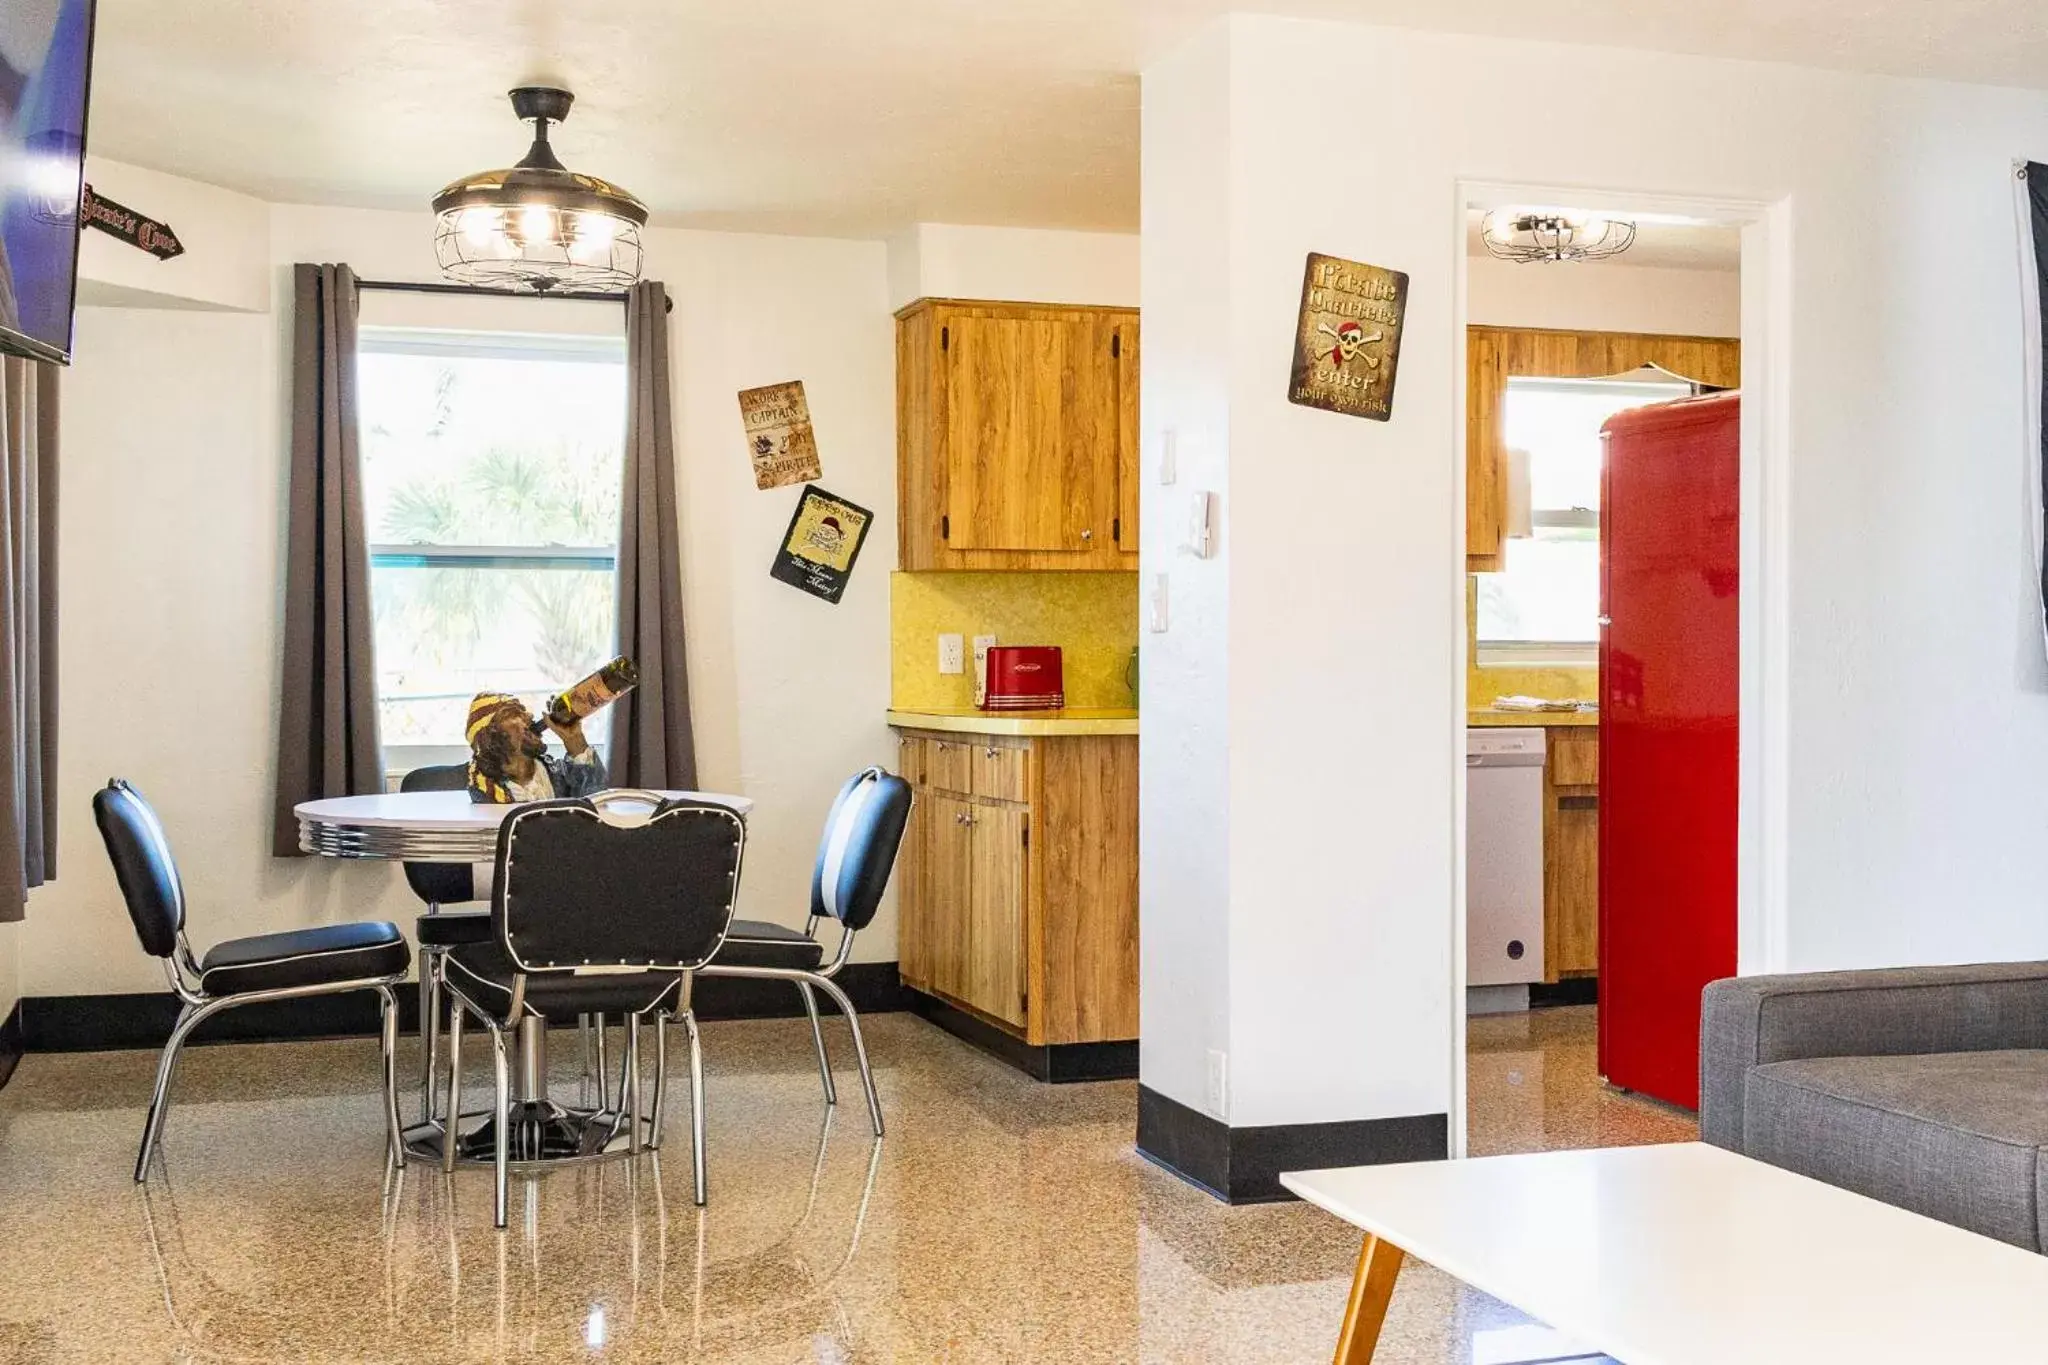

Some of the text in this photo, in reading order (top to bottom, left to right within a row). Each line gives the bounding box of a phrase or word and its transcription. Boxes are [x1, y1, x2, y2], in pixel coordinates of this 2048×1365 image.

[1312, 262, 1397, 301] Pirate
[1317, 368, 1375, 390] enter
[1295, 386, 1327, 402] your
[1361, 398, 1388, 413] risk
[750, 406, 798, 424] CAPTAIN
